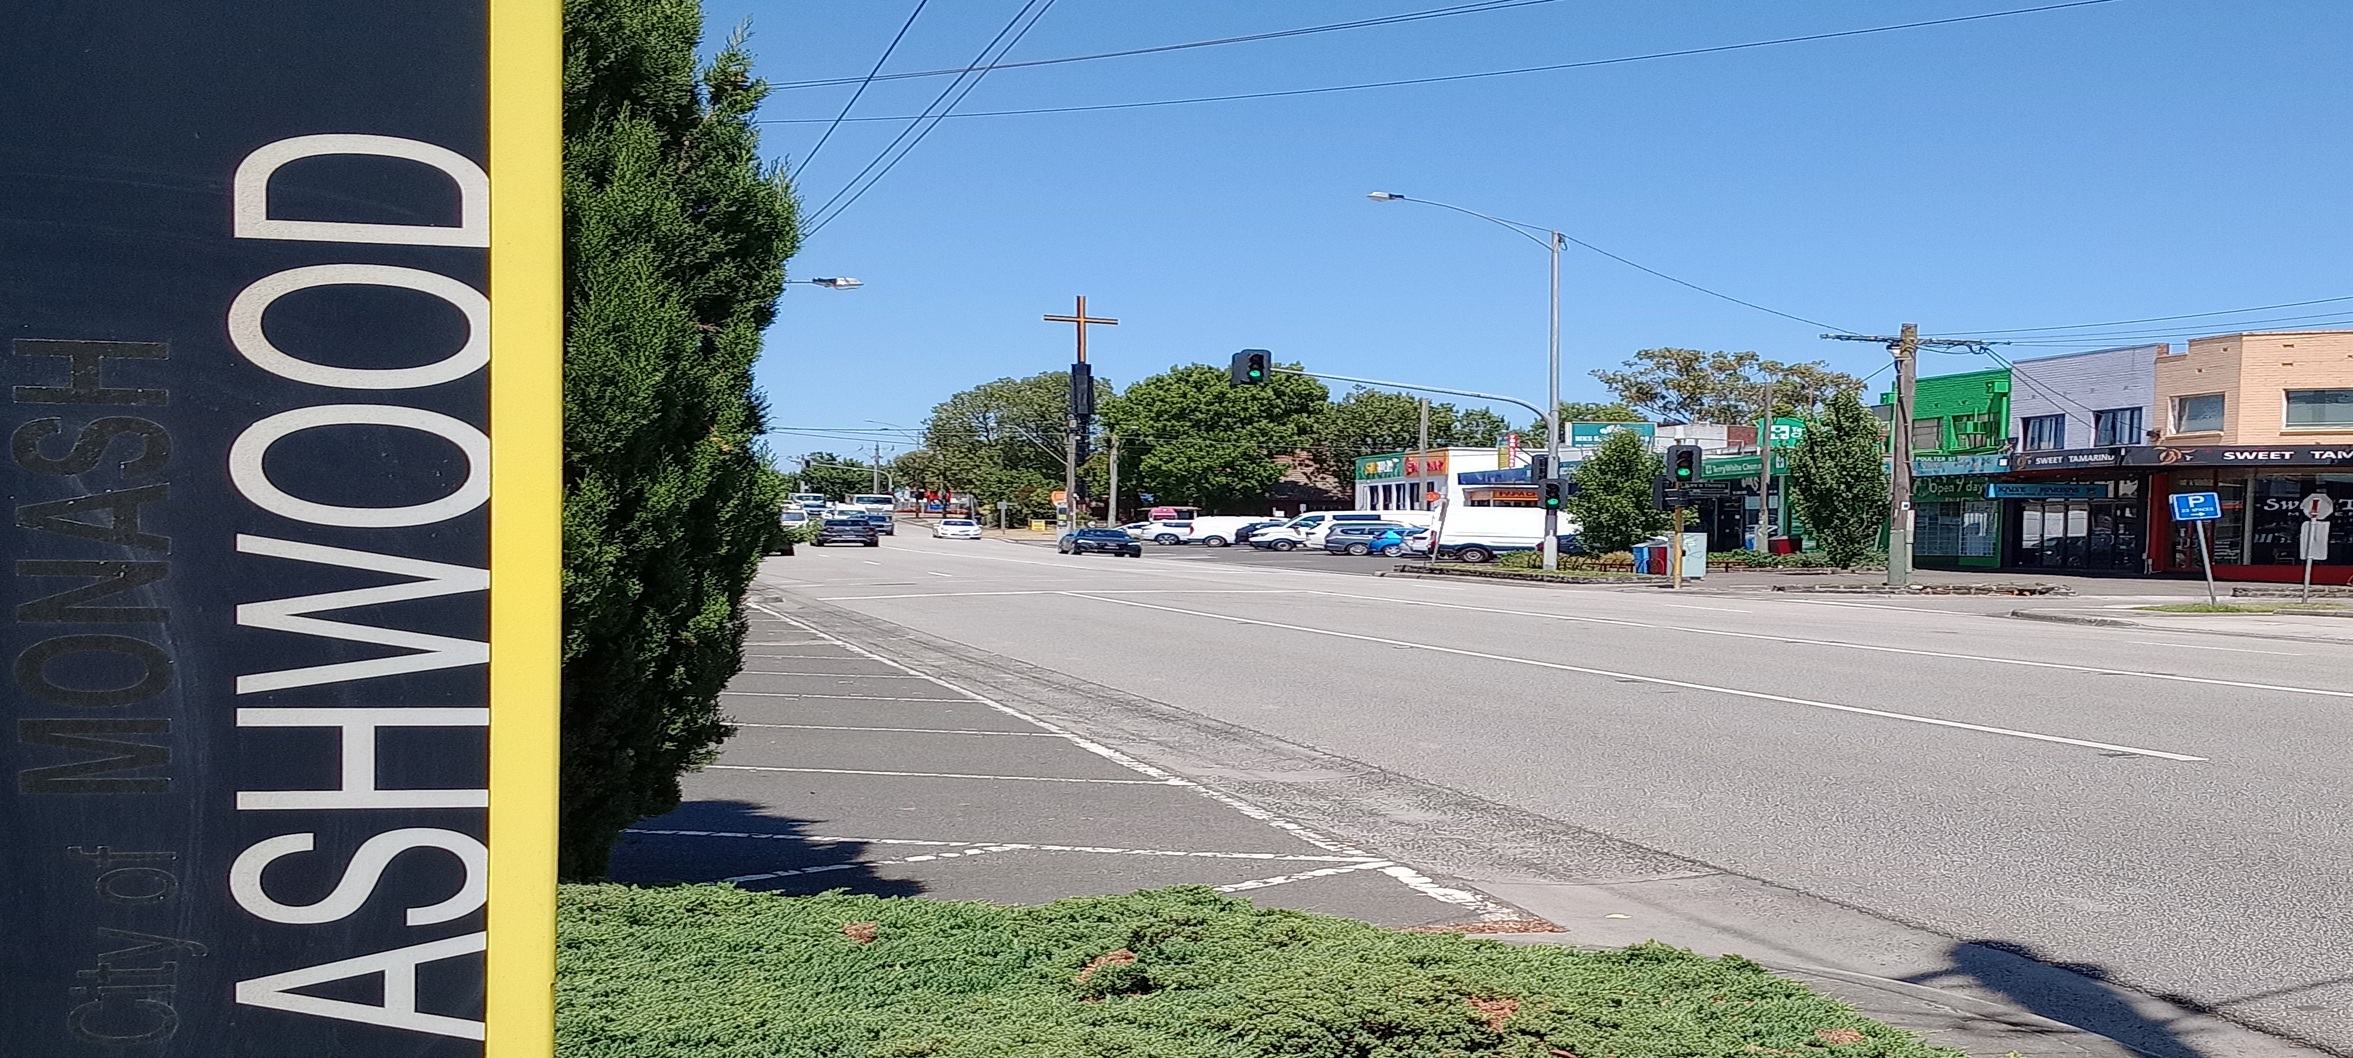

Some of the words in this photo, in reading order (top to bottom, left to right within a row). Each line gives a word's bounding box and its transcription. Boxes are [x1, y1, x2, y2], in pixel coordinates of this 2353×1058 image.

[2035, 456, 2064, 465] SWEET
[2068, 453, 2115, 463] TAMARIND
[2223, 450, 2295, 460] SWEET
[2187, 495, 2205, 508] P
[13, 337, 173, 796] MONASH
[227, 133, 491, 1041] ASHWOOD
[67, 843, 178, 906] of
[67, 924, 209, 1046] City
